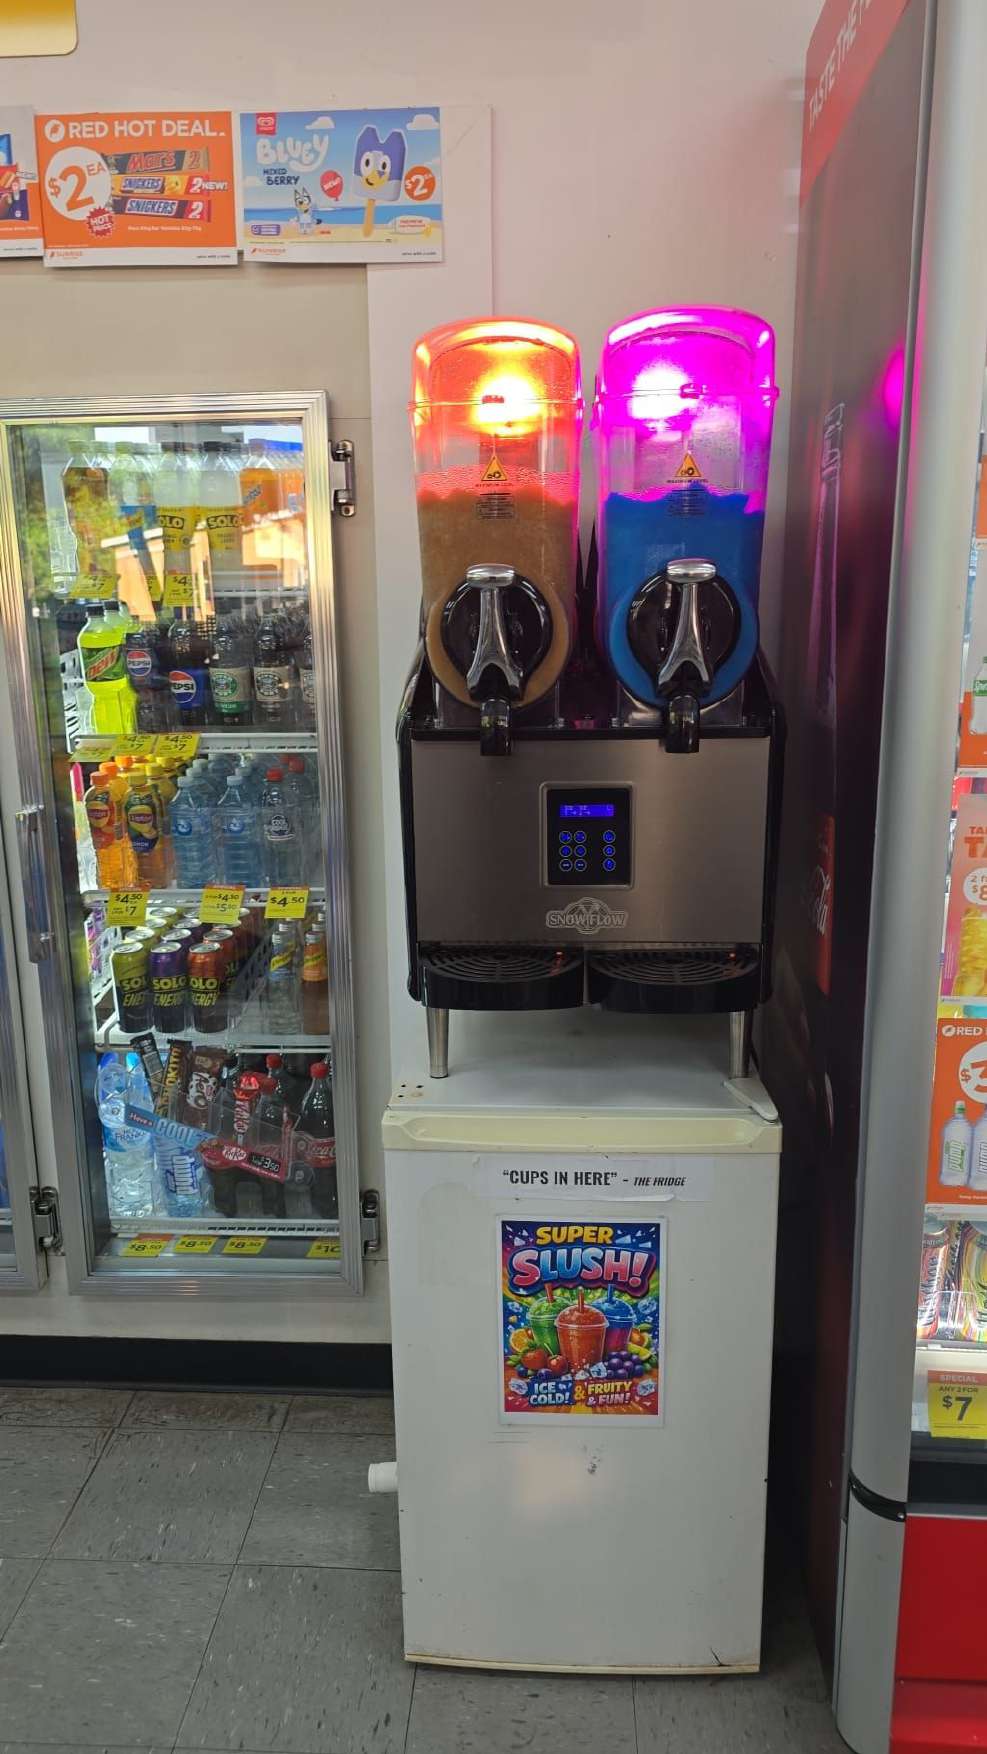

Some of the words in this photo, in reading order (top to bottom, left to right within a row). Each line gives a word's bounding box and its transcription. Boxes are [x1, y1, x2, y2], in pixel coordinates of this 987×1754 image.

[809, 47, 836, 132] TASTE
[68, 121, 109, 138] RED
[114, 120, 156, 137] HOT
[123, 177, 162, 189] SNICKERS
[266, 175, 300, 186] BERRY
[48, 165, 95, 211] $2
[127, 199, 178, 216] SNICKERS
[90, 215, 110, 226] HOT
[158, 516, 184, 529] OLO
[190, 978, 218, 990] OLO
[956, 1025, 984, 1037] RED
[555, 1171, 568, 1185] IN
[634, 1177, 651, 1186] THE
[653, 1177, 687, 1187] FRIDGE
[536, 1225, 614, 1245] SUPER
[512, 1247, 649, 1287] SLUSH!
[939, 1375, 978, 1384] SPECIAL
[534, 1381, 556, 1394] ICE
[574, 1384, 586, 1400] &
[587, 1380, 632, 1394] FRUITY
[529, 1392, 570, 1406] COLD!
[599, 1393, 631, 1405] FUN!
[941, 1396, 973, 1421] $7
